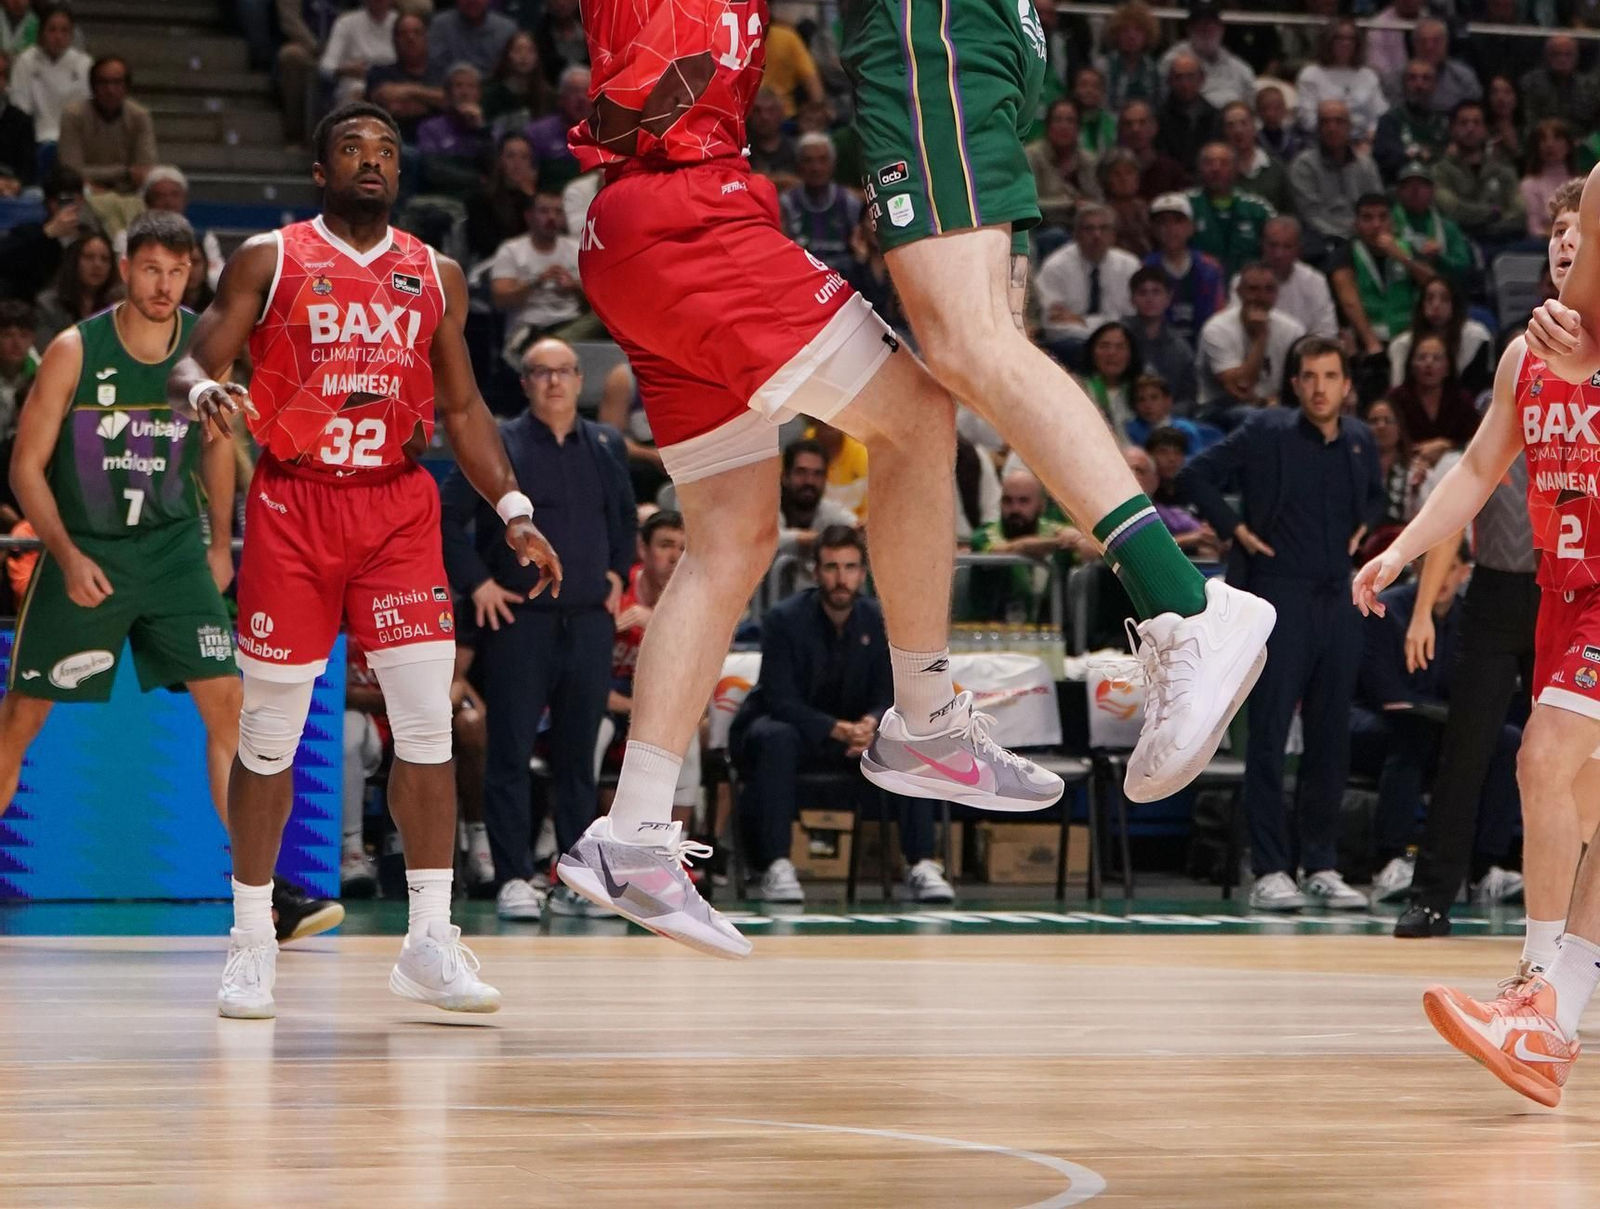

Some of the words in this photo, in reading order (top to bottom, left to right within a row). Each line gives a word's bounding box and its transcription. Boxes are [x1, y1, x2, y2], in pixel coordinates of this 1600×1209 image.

[719, 11, 763, 71] 12
[881, 170, 902, 184] acb
[306, 302, 421, 349] BAXI
[322, 373, 400, 399] MANRESA
[320, 417, 387, 466] 32
[123, 488, 145, 527] 7
[1556, 514, 1585, 560] 2
[372, 589, 428, 611] Adbisio
[374, 608, 404, 629] ETL
[378, 622, 434, 644] GLOBAL
[200, 643, 232, 661] laga
[238, 633, 292, 661] unilabor
